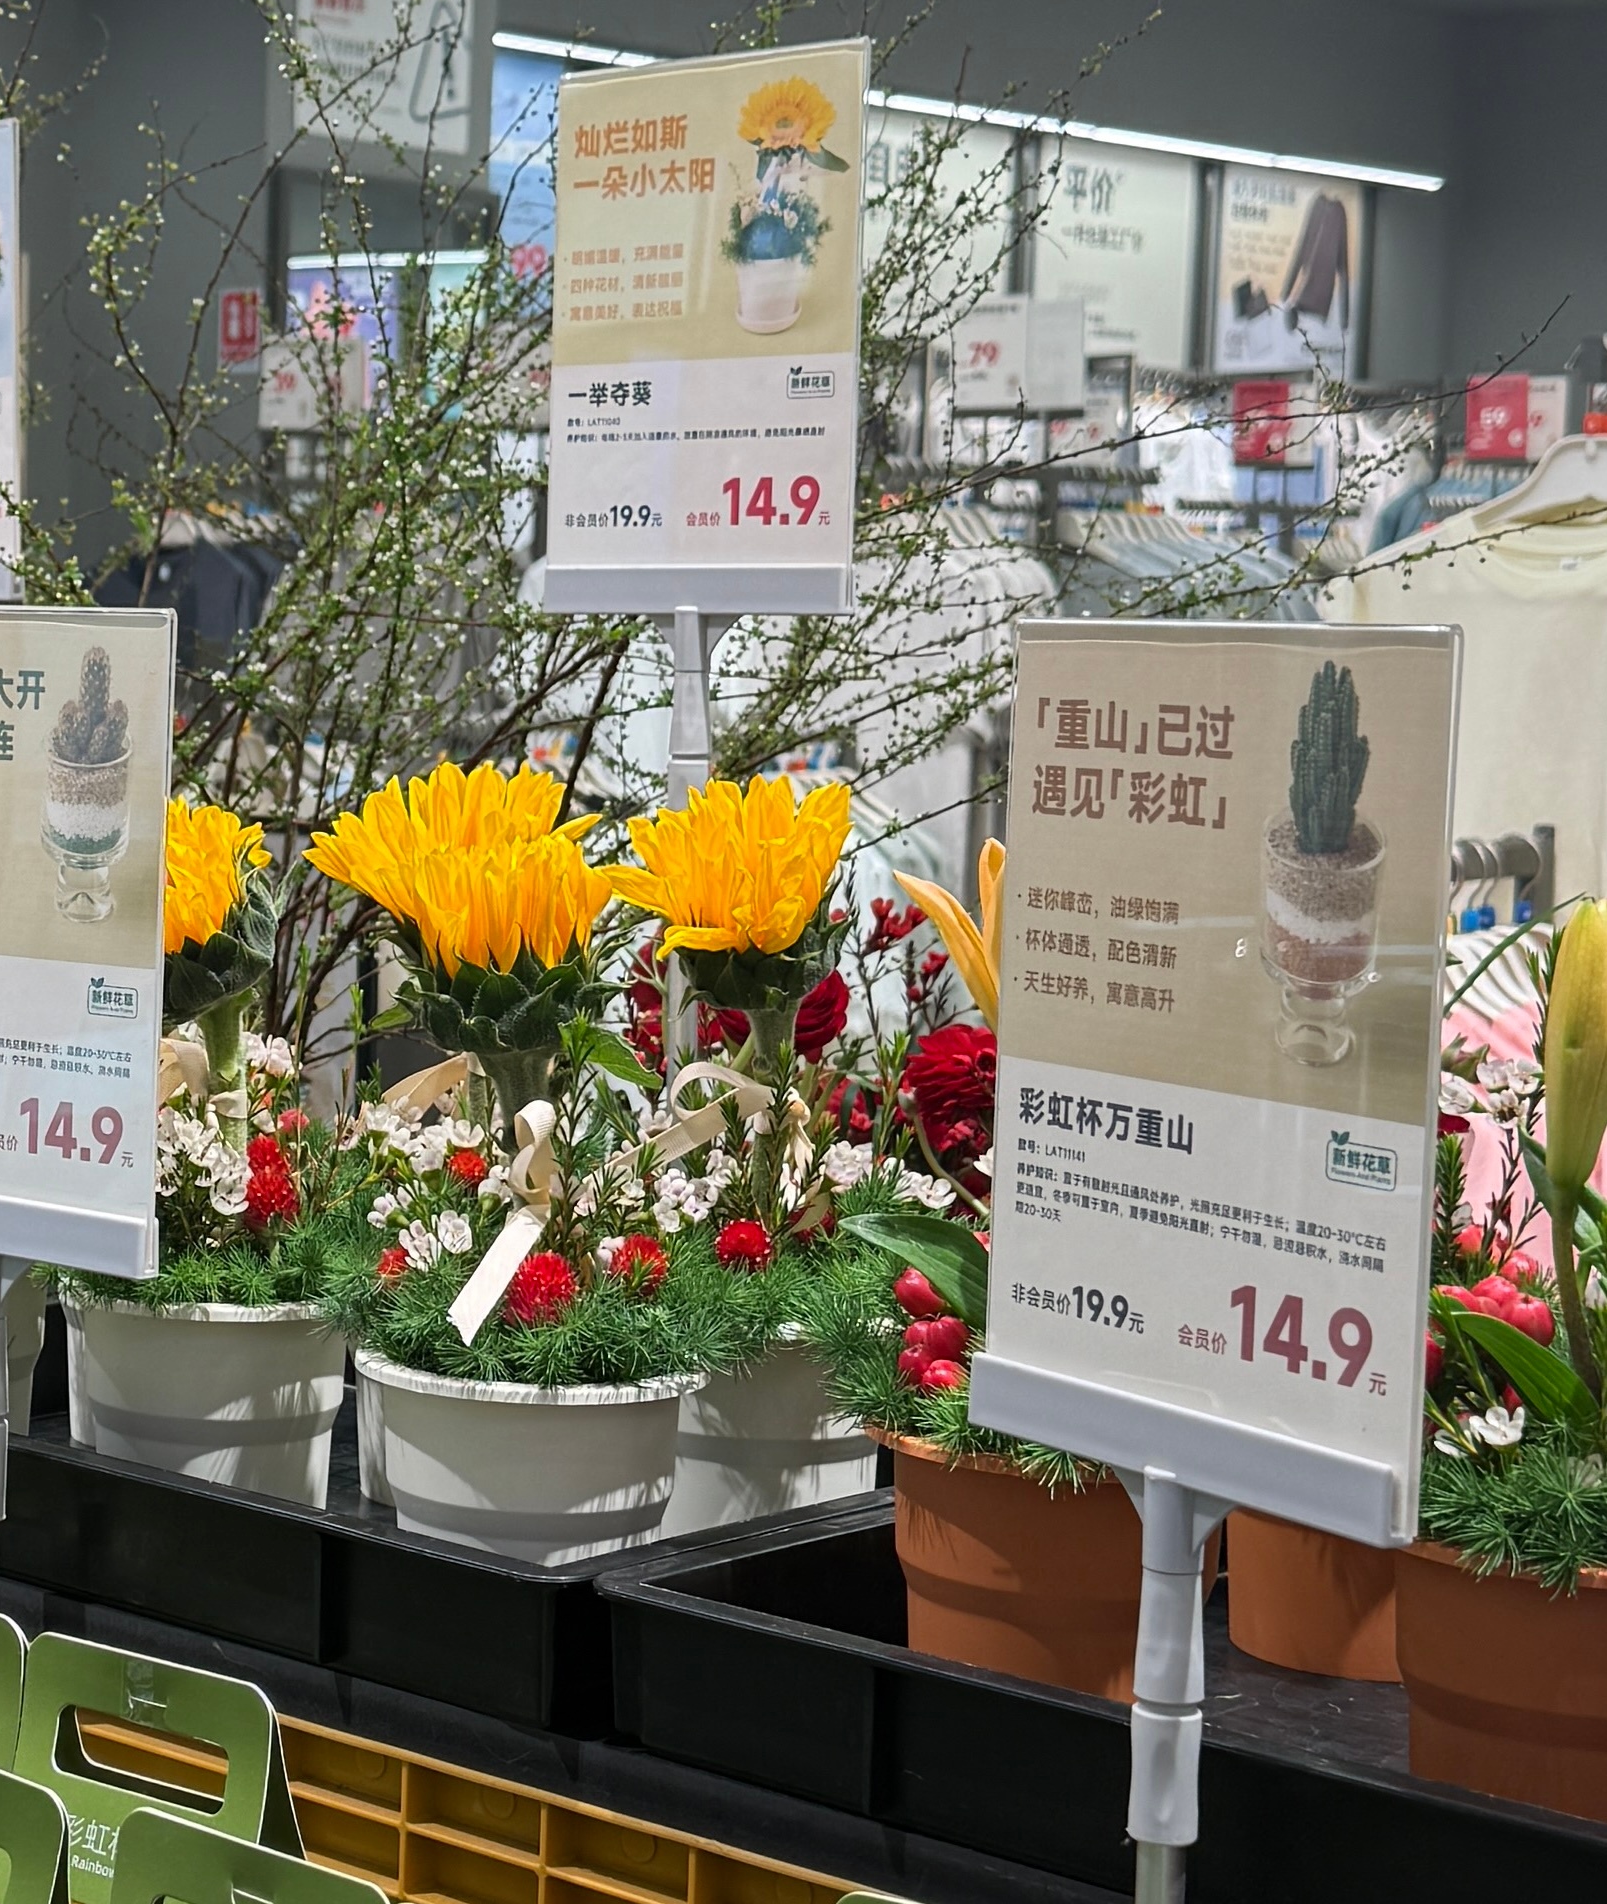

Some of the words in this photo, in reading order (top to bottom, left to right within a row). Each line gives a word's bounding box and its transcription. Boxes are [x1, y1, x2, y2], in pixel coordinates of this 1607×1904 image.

[575, 113, 688, 159] 灿烂如斯
[573, 157, 716, 200] 一朵小太阳
[568, 380, 652, 408] 一举夺葵
[1037, 697, 1235, 760] 「重山」已过
[1032, 764, 1227, 830] 遇见「彩虹」
[1023, 970, 1175, 1013] 天生好养，寓意高升
[1019, 1087, 1194, 1155] 彩虹杯万重山
[1011, 1282, 1144, 1334] 非会员价19.9元
[1178, 1285, 1387, 1396] 会员价14.9元
